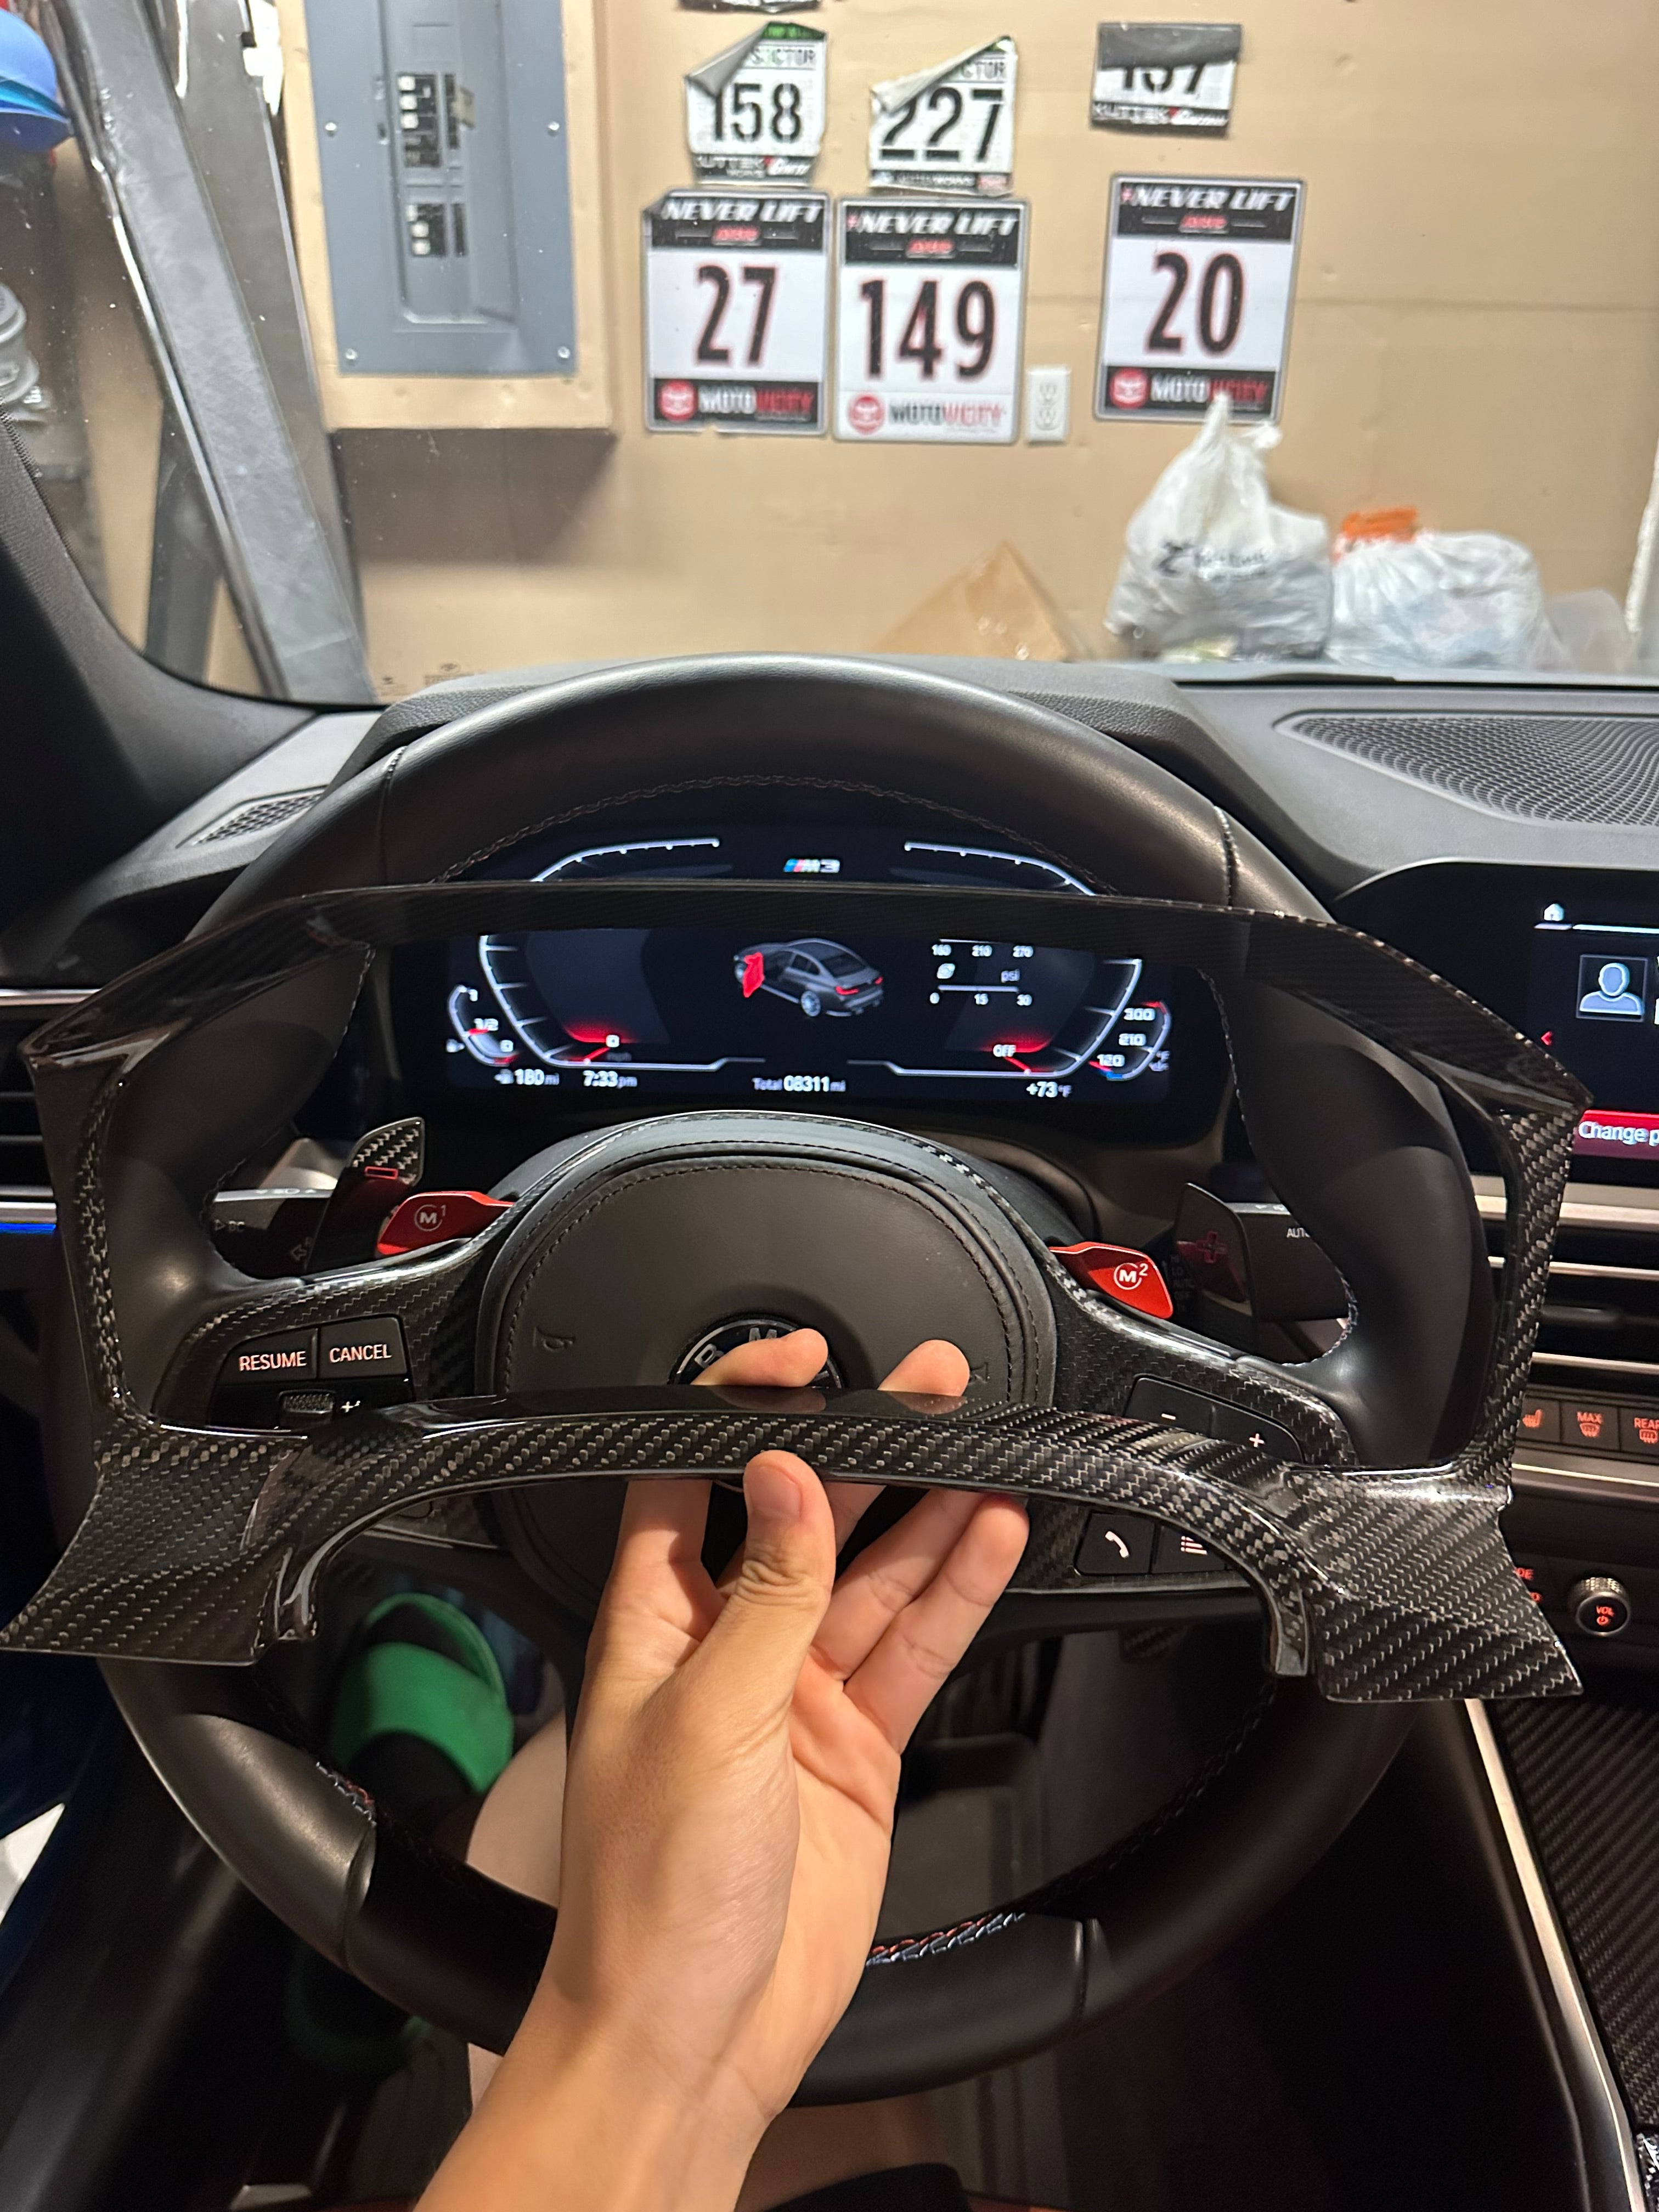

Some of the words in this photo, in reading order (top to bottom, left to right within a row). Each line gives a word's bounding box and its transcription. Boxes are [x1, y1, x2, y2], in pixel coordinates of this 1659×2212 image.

[714, 83, 802, 143] 158
[881, 87, 1003, 162] 227
[1146, 252, 1244, 356] 20
[697, 265, 778, 365] 27
[860, 279, 995, 380] 149
[1017, 994, 1032, 1006] 30
[1124, 1008, 1155, 1021] 300
[993, 1044, 1016, 1058] OFF
[583, 1070, 619, 1087] 7:33
[1578, 1121, 1648, 1145] Change
[1286, 1227, 1311, 1238] AUT
[238, 1351, 307, 1371] RESUME
[330, 1344, 392, 1363] CANCEL
[1577, 1412, 1604, 1425] MAX
[1596, 1605, 1614, 1617] VOL
